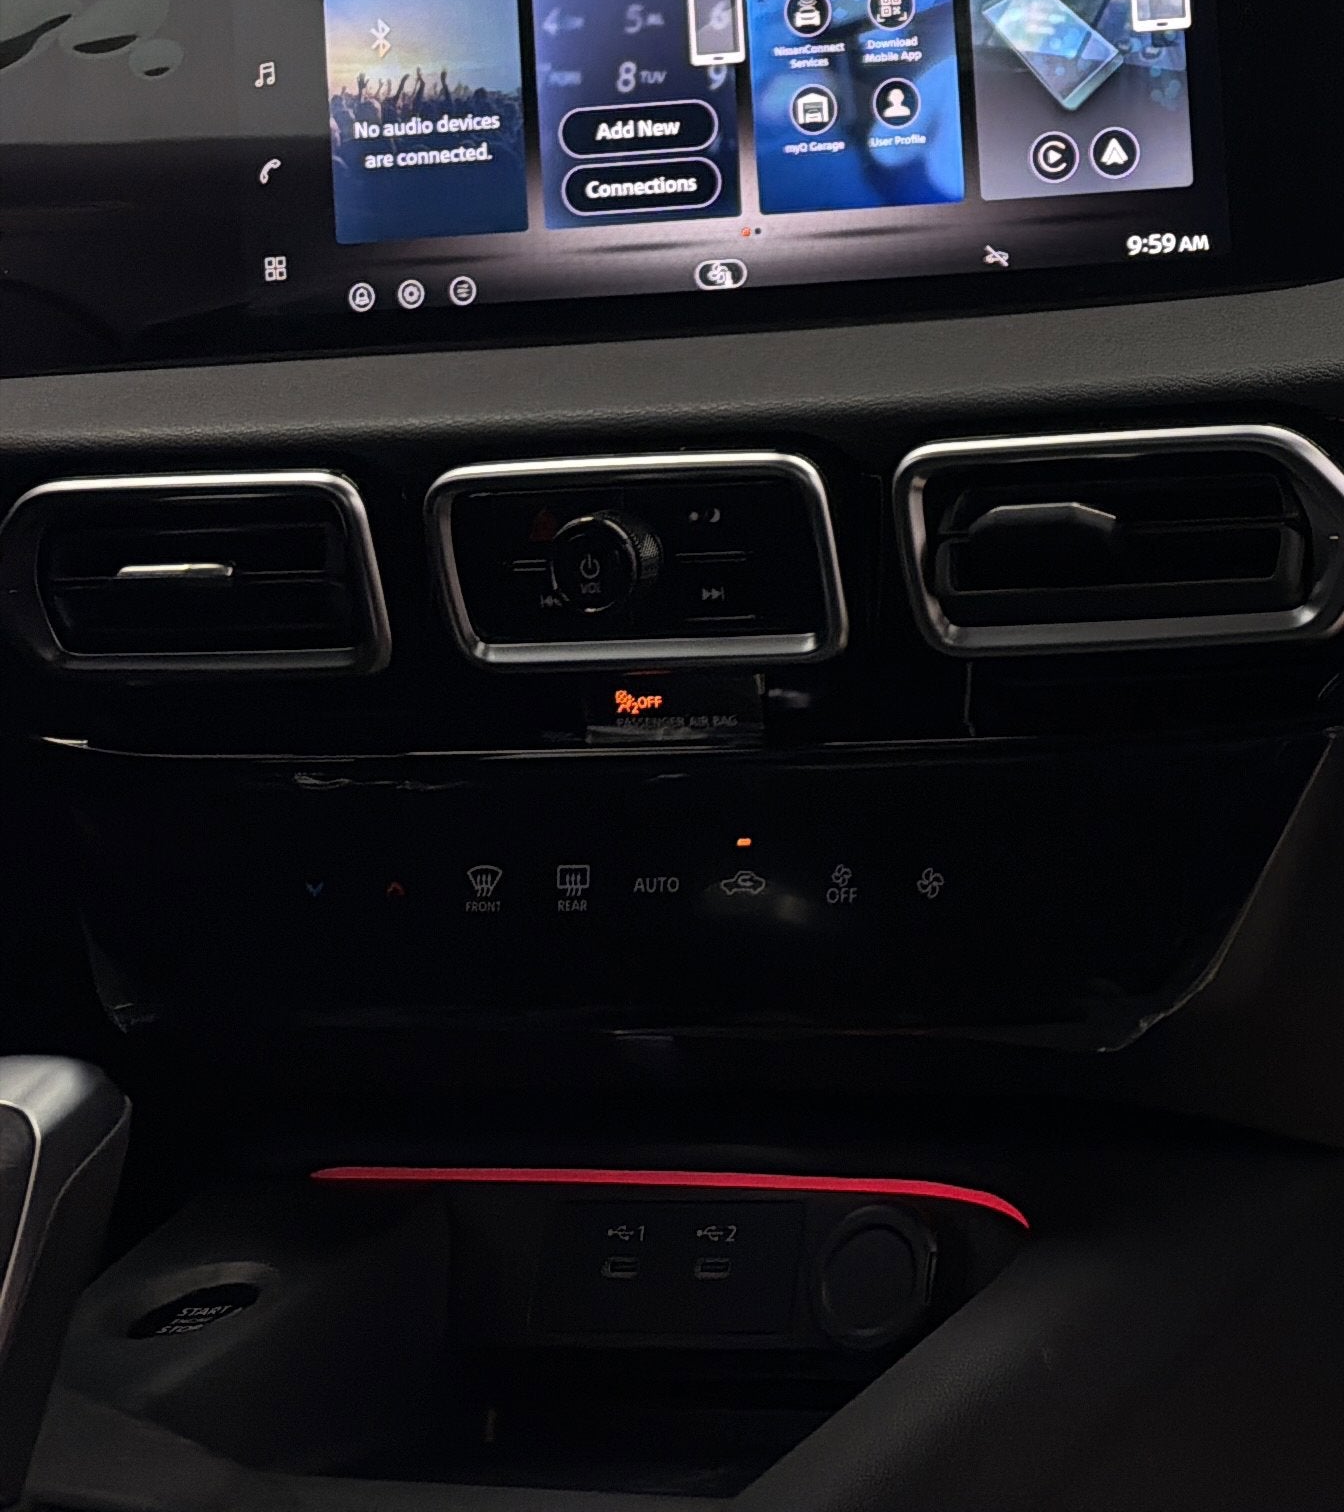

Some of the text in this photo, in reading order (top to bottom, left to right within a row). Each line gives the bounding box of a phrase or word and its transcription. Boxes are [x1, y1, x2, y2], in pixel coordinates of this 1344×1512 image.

[867, 36, 918, 50] Download
[790, 57, 829, 69] Services
[864, 48, 922, 63] Mobile App
[616, 61, 637, 92] 8
[354, 113, 500, 139] No audio devices
[596, 118, 681, 140] Add New
[812, 139, 845, 154] Garage
[870, 133, 926, 148] User Profile
[365, 143, 493, 169] are connected.
[585, 176, 697, 199] Connections
[1126, 233, 1210, 255] 9:59 AM
[637, 695, 663, 709] OFF
[634, 877, 680, 893] AUTO
[826, 889, 858, 905] OFF
[465, 901, 502, 912] FRONT
[557, 900, 588, 912] REAR
[636, 1225, 646, 1241] 1
[725, 1224, 738, 1241] 2
[176, 1304, 233, 1317] START
